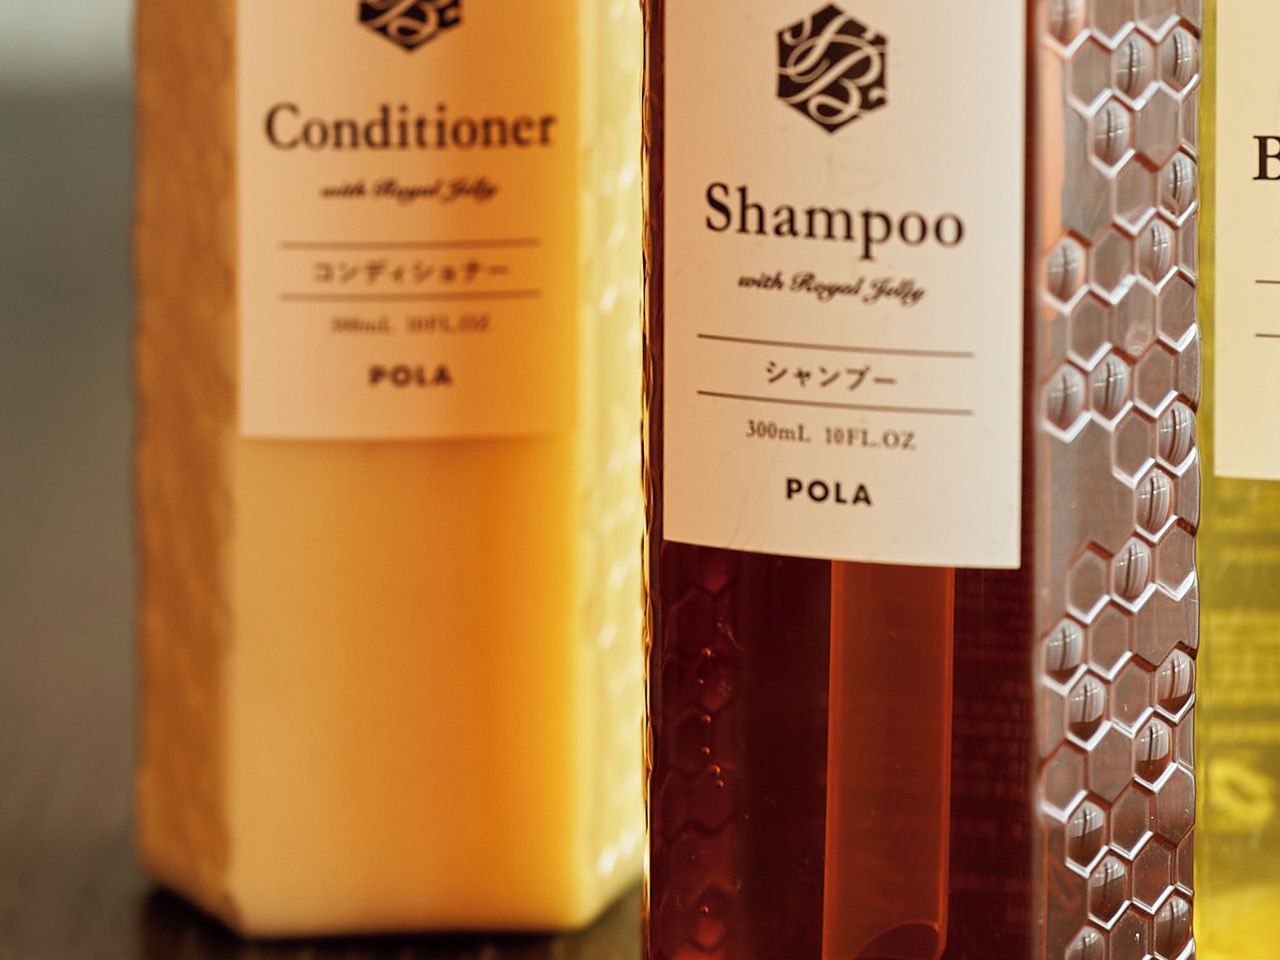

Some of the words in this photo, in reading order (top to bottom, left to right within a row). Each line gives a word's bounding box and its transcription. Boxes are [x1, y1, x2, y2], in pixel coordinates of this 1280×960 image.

[263, 102, 557, 151] Conditioner
[705, 181, 965, 262] Shampoo
[737, 271, 785, 291] with
[789, 271, 865, 303] Royal
[861, 277, 926, 307] Jelly
[368, 364, 453, 389] POLA
[746, 418, 812, 444] 300mL
[824, 426, 916, 451] 10FL.OZ
[785, 477, 873, 507] POLA
